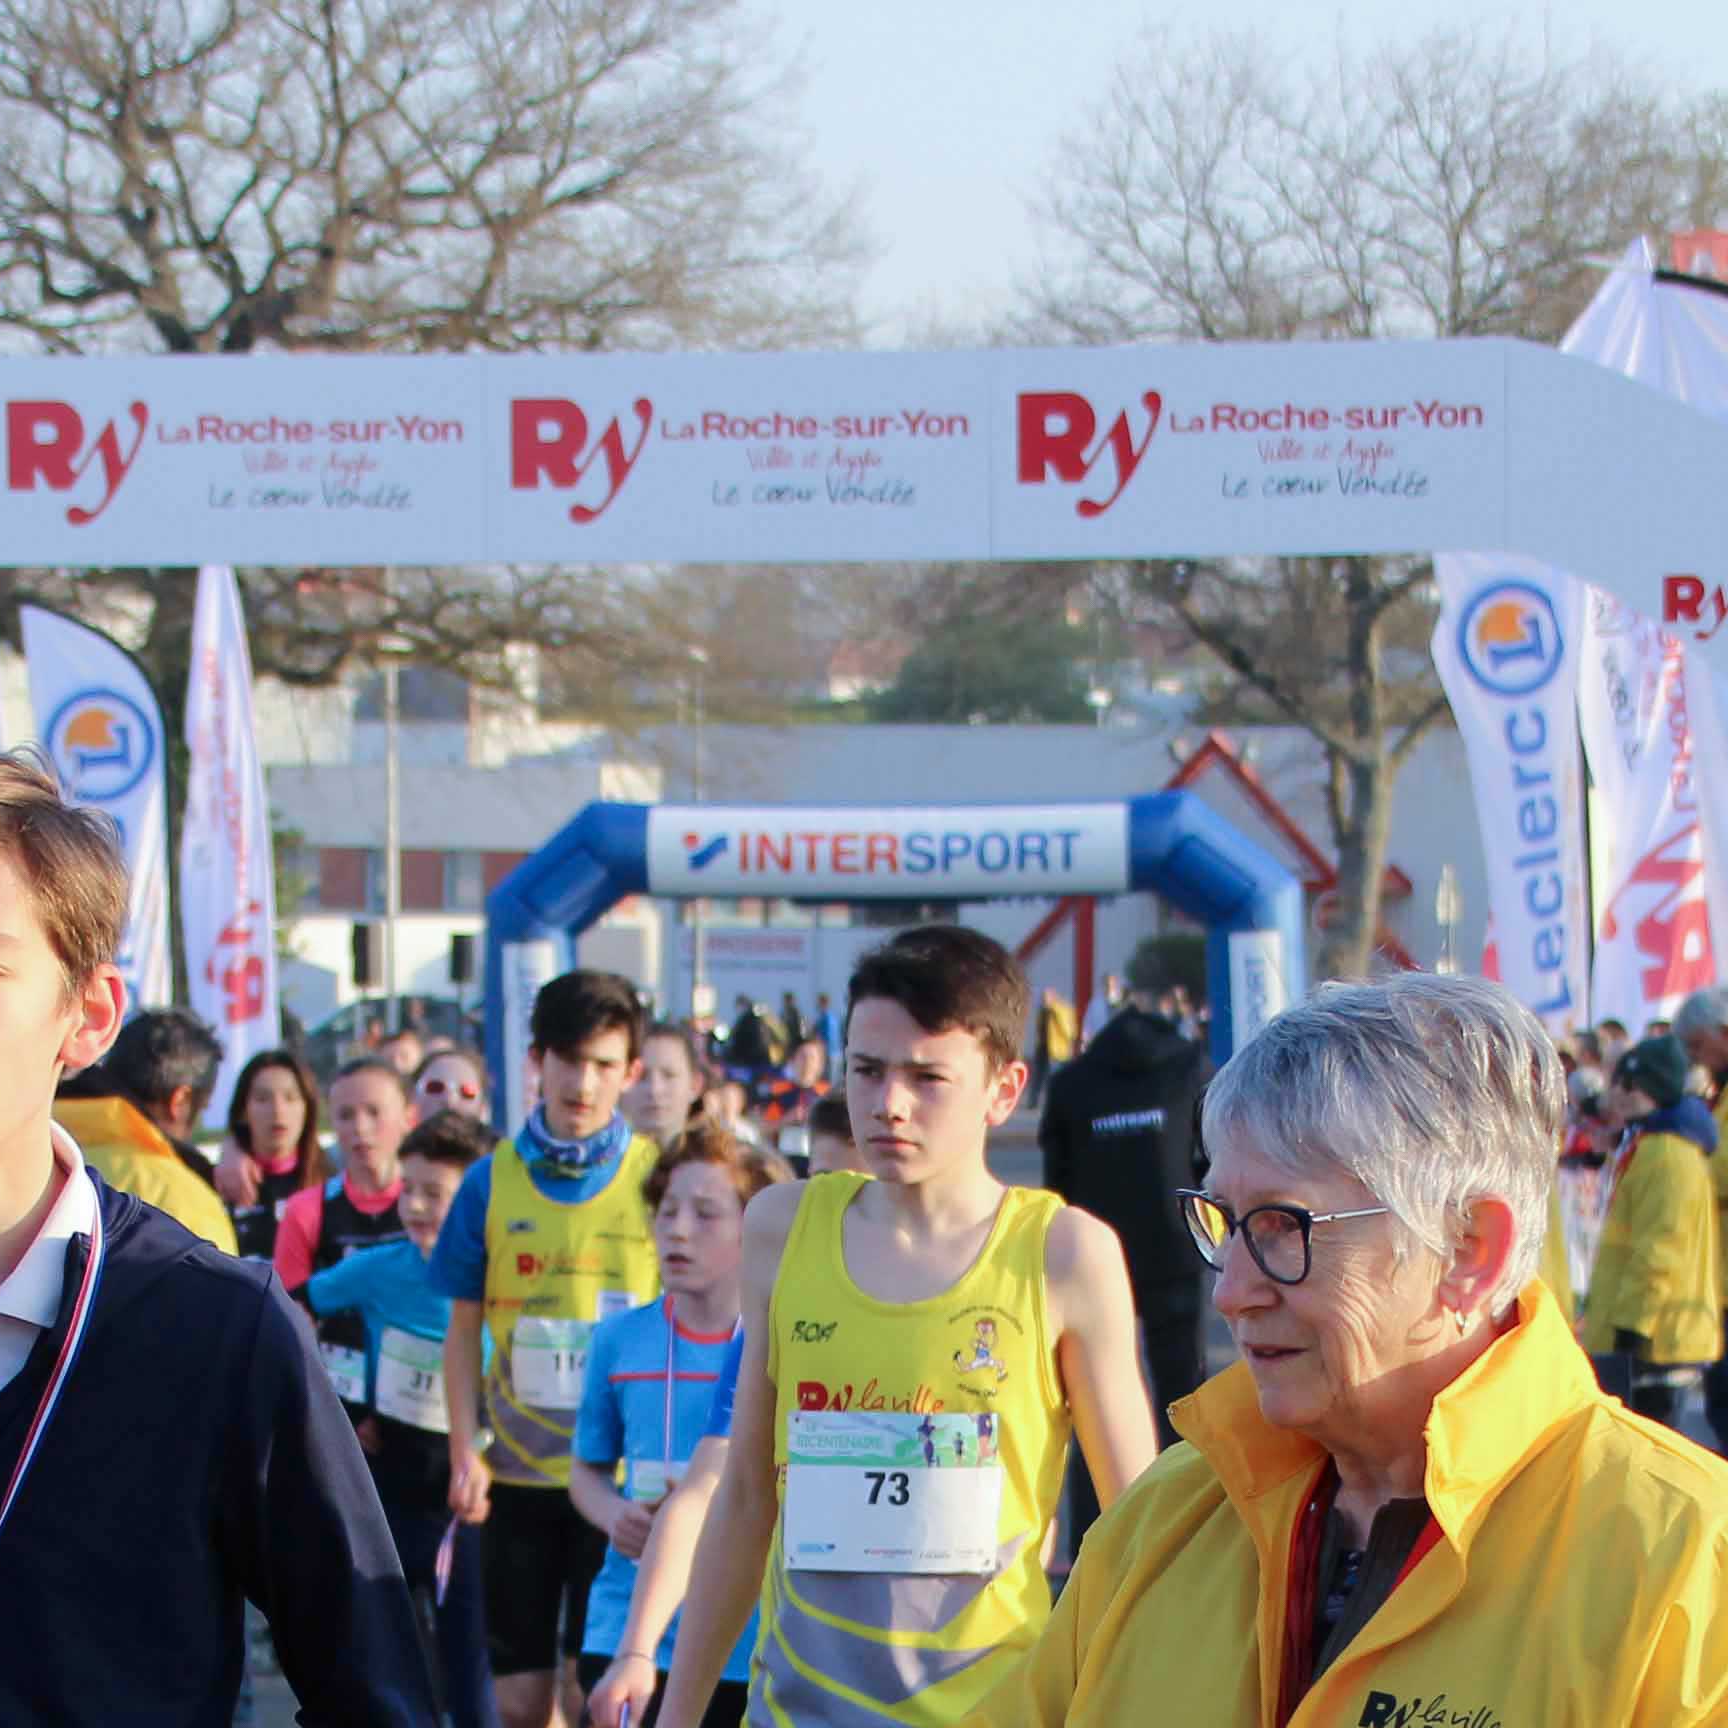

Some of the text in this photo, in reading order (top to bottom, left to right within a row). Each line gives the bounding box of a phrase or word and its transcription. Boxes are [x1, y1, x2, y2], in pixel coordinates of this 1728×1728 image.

[158, 415, 464, 444] La Roche-sur-Yon
[661, 411, 970, 441] La Roche-sur-Yon
[1171, 401, 1484, 433] La Roche-sur-Yon
[5, 400, 149, 525] Ry
[511, 398, 653, 523] Ry
[1017, 389, 1162, 518] Ry
[739, 831, 1081, 874] INTERSPORT
[1504, 706, 1571, 1014] Leclerc
[891, 1382, 944, 1413] ville
[864, 1471, 910, 1506] 73
[1418, 1694, 1447, 1723] la
